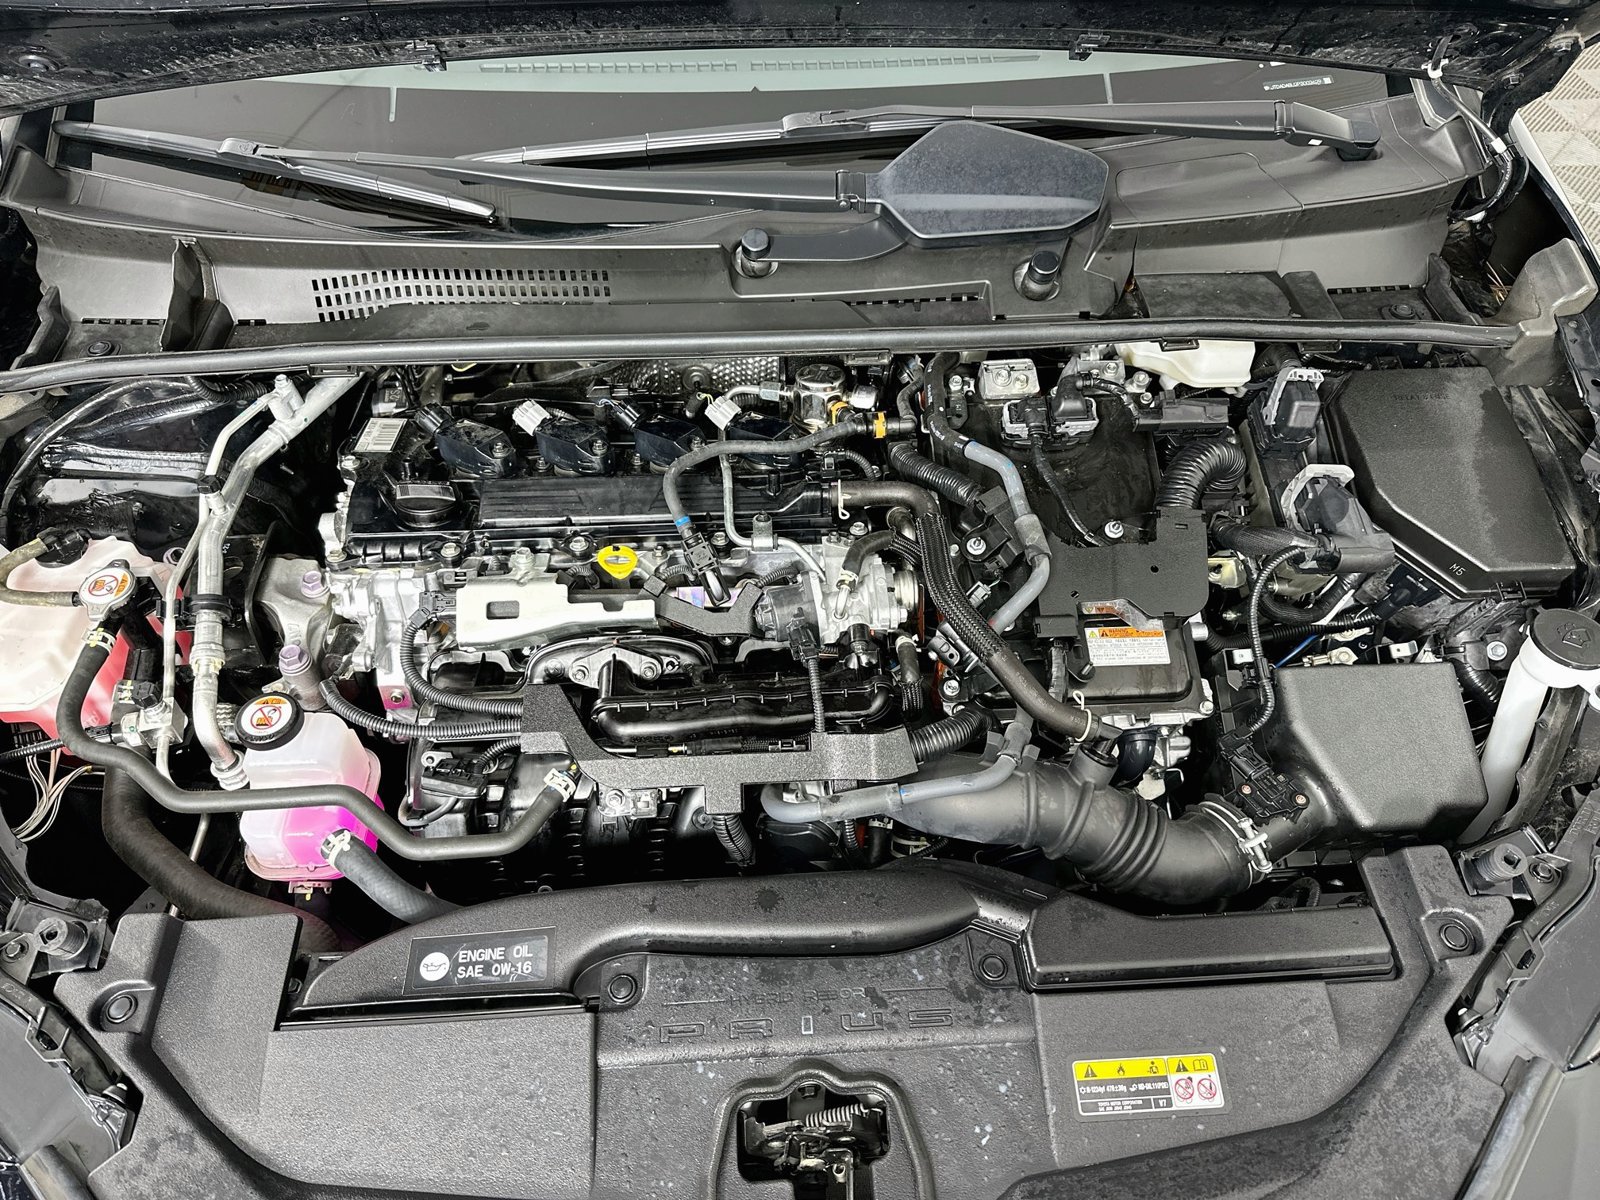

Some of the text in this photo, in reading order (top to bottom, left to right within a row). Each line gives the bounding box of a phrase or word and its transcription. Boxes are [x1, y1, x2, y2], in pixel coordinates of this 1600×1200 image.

[458, 944, 533, 963] ENGINE OIL
[456, 961, 532, 979] SAE 0W-16
[727, 990, 794, 1007] HYBRID
[659, 1008, 954, 1044] PRIUS
